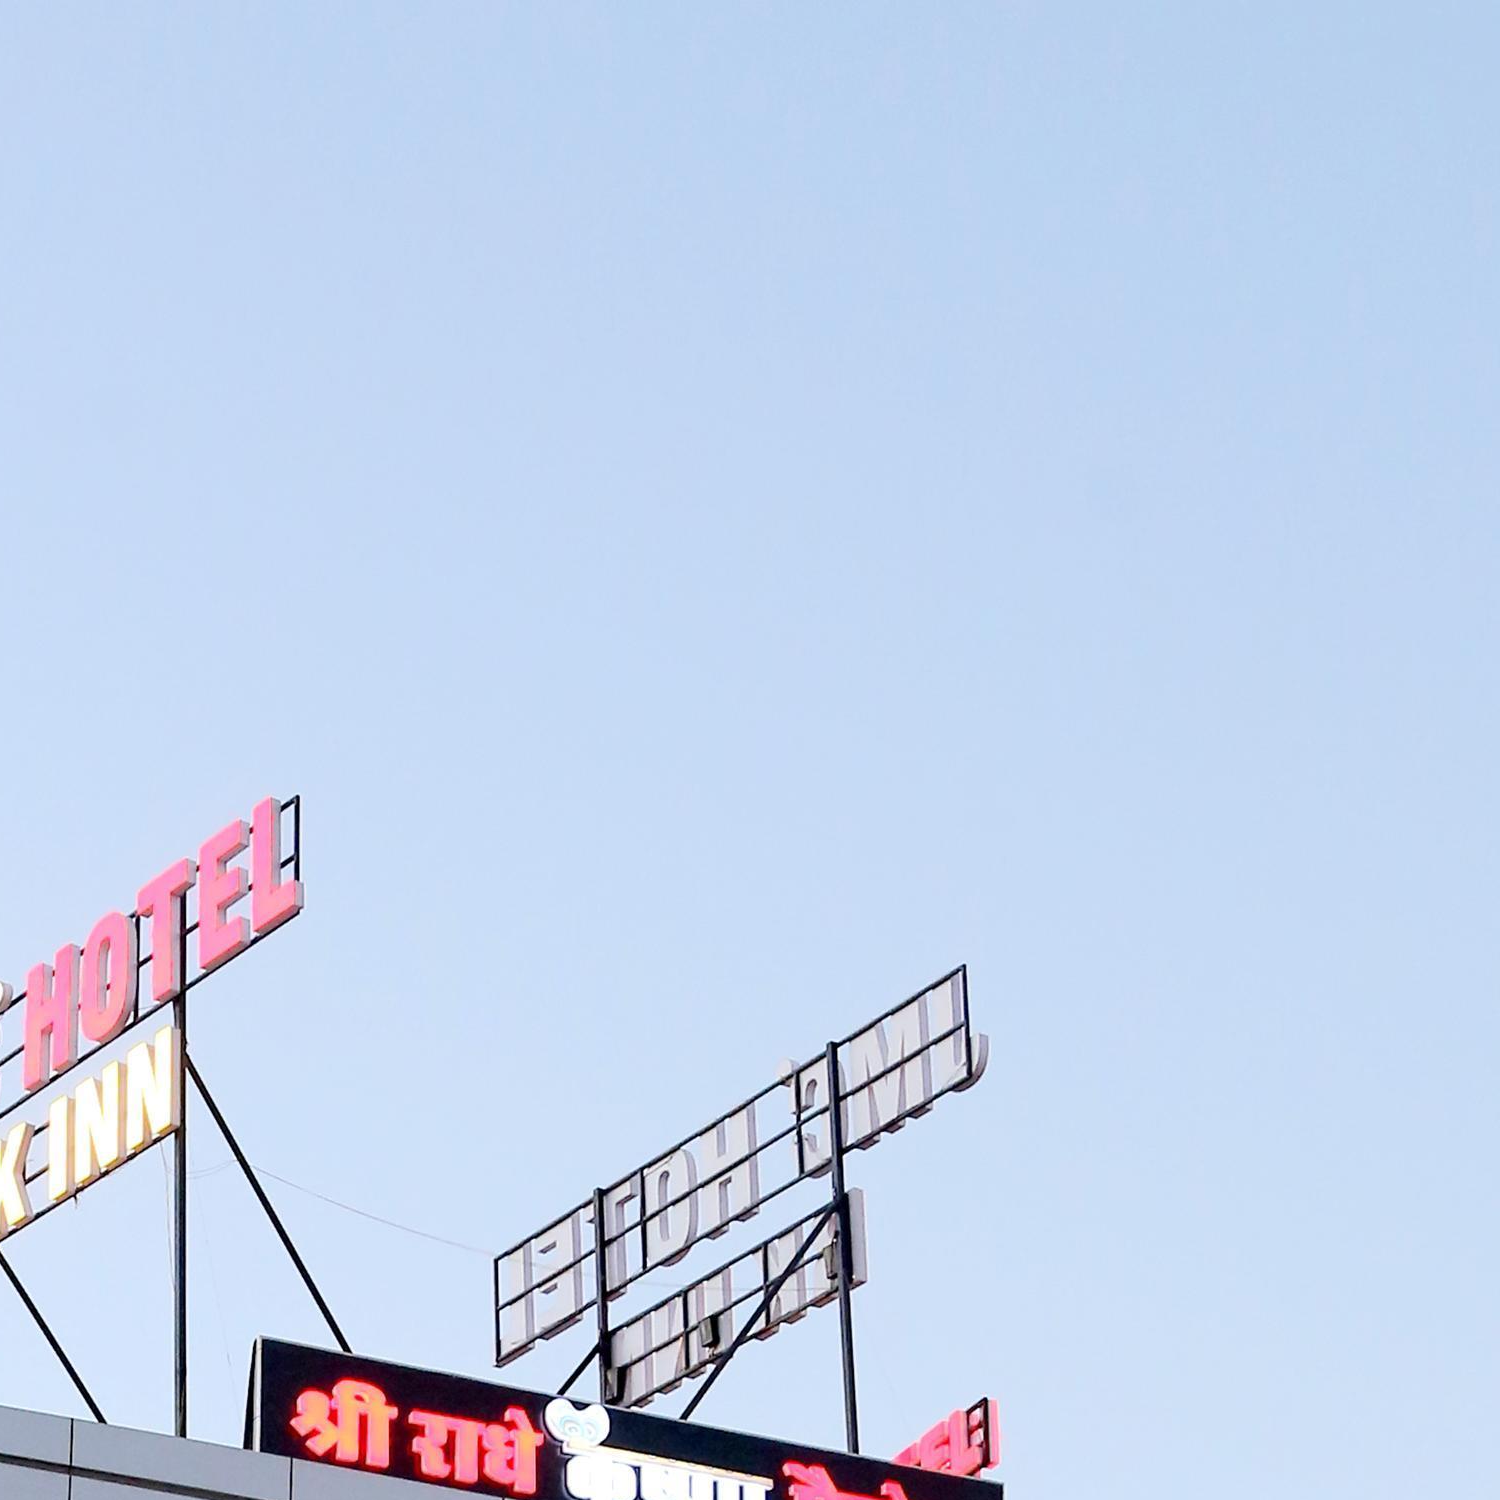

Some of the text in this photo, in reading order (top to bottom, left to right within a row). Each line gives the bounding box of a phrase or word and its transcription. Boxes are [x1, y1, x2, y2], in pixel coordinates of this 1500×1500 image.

[23, 796, 304, 1093] HOTEL
[48, 1024, 182, 1204] INN
[289, 1376, 399, 1469] श्री
[407, 1405, 545, 1496] राधे
